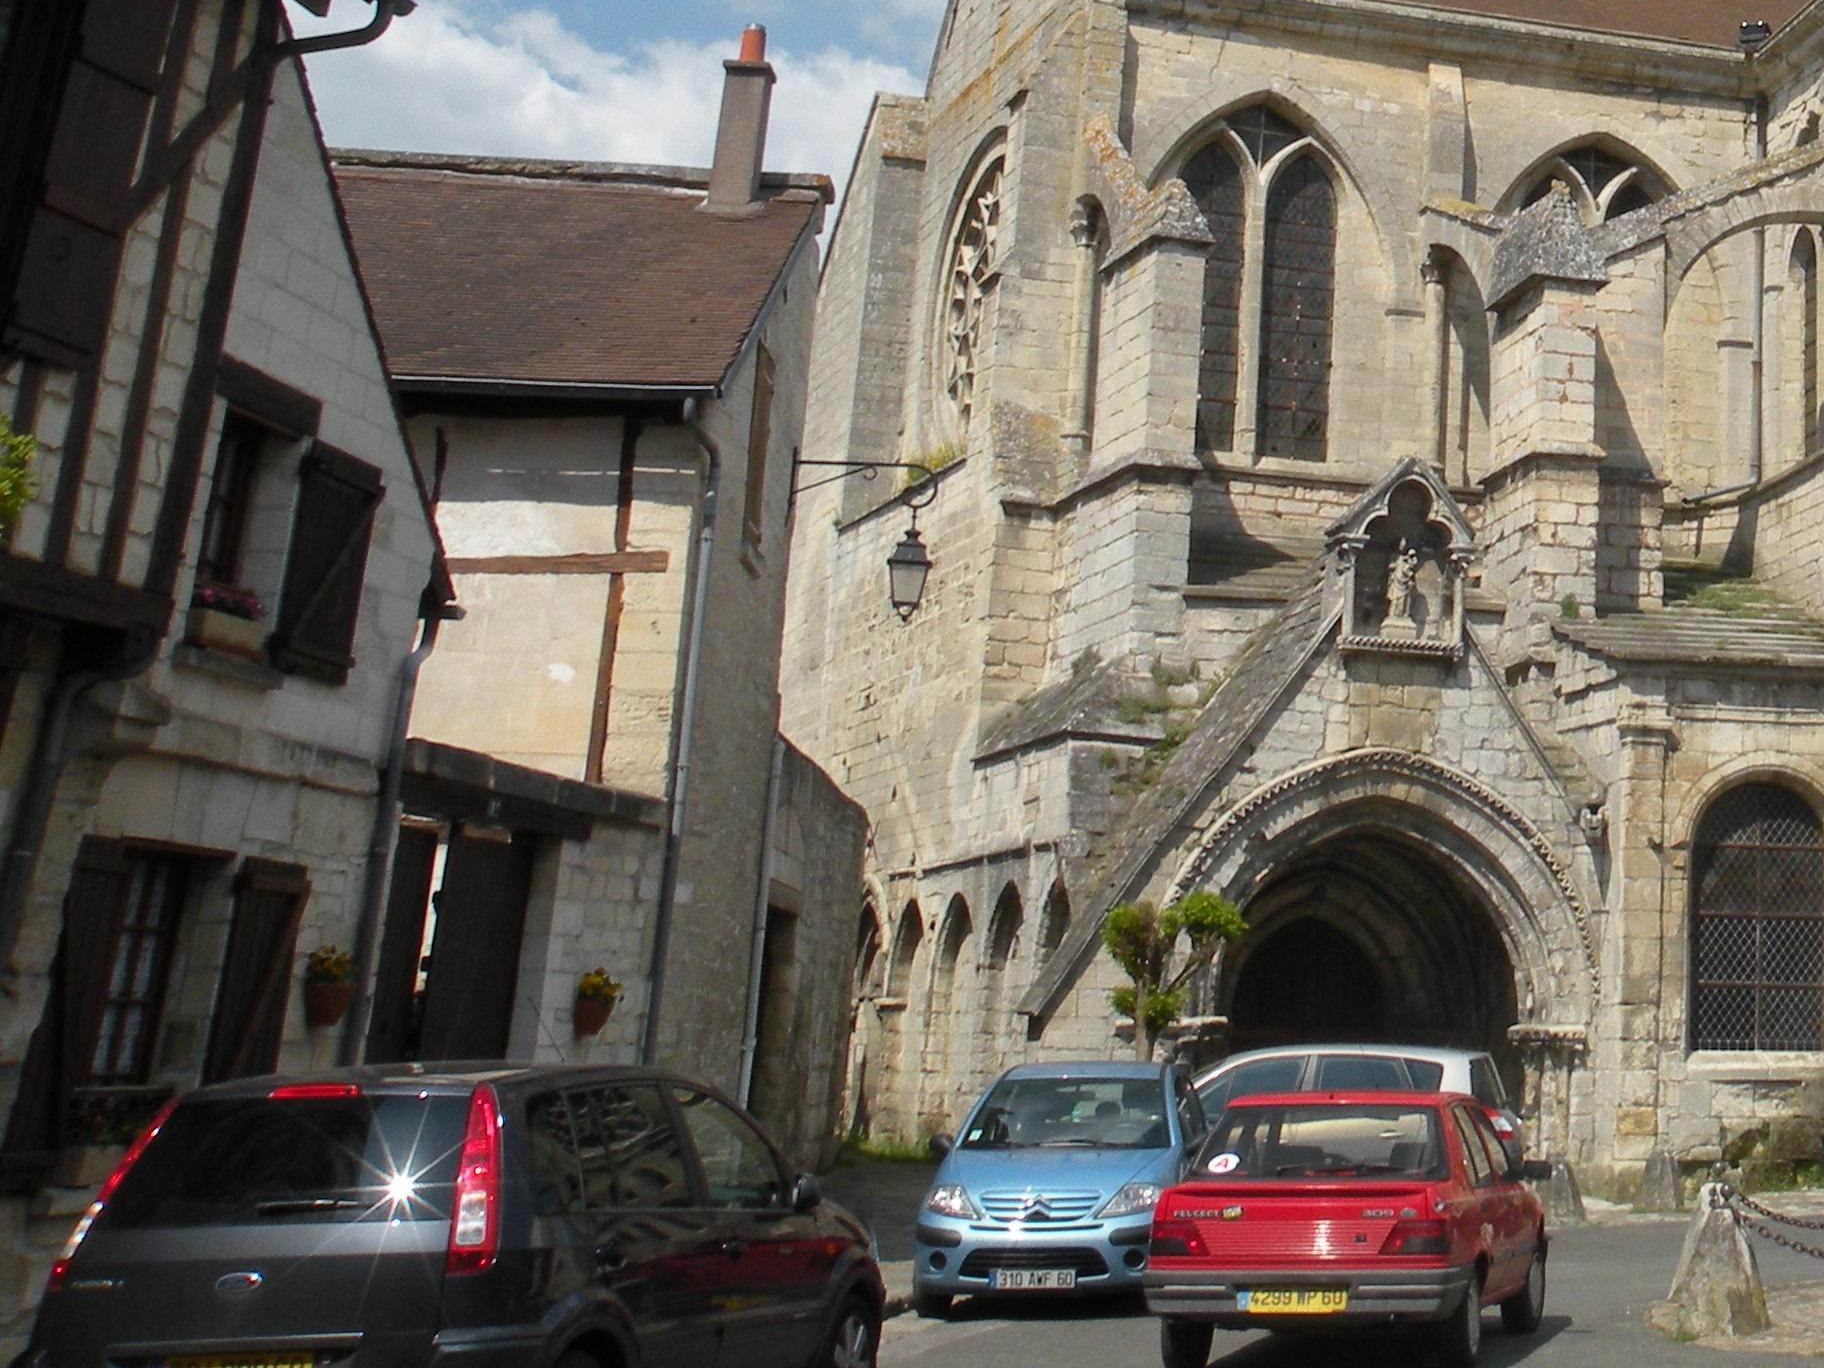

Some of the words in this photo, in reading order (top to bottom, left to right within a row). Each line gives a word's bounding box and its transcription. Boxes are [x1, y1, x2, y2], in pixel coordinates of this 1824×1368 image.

[1214, 1157, 1229, 1169] A
[998, 1271, 1024, 1287] 310
[1057, 1270, 1073, 1286] 60
[1321, 1288, 1343, 1306] 60
